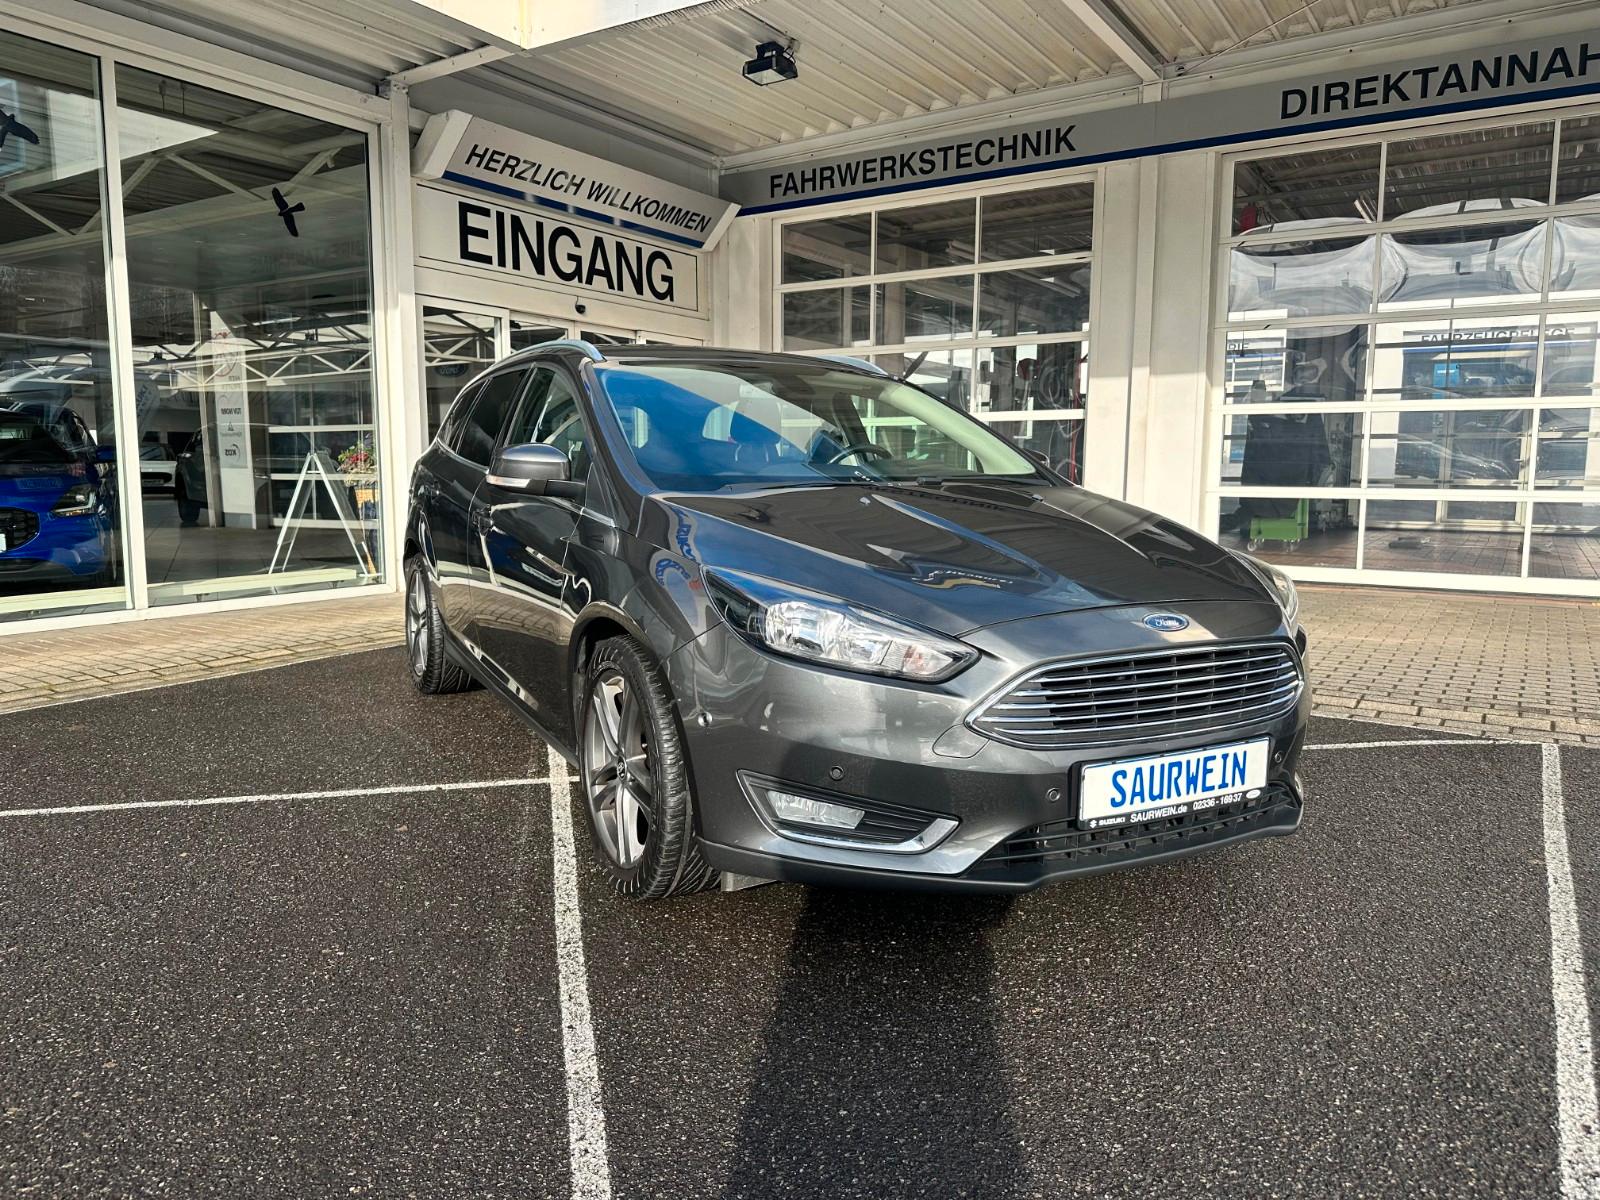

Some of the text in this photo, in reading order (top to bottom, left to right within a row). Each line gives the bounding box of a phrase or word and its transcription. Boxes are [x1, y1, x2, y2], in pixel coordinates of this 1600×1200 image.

[1280, 43, 1600, 119] DIREKTANNAH
[464, 143, 712, 233] HERZLICH WILLKOMMEN
[770, 125, 1077, 198] FAHRWERKSTECHNIK
[458, 200, 675, 302] EINGANG
[1098, 817, 1126, 826] SUZUKI
[1130, 804, 1188, 823] SAURWEIN.de
[1110, 750, 1248, 808] SAURWEIN
